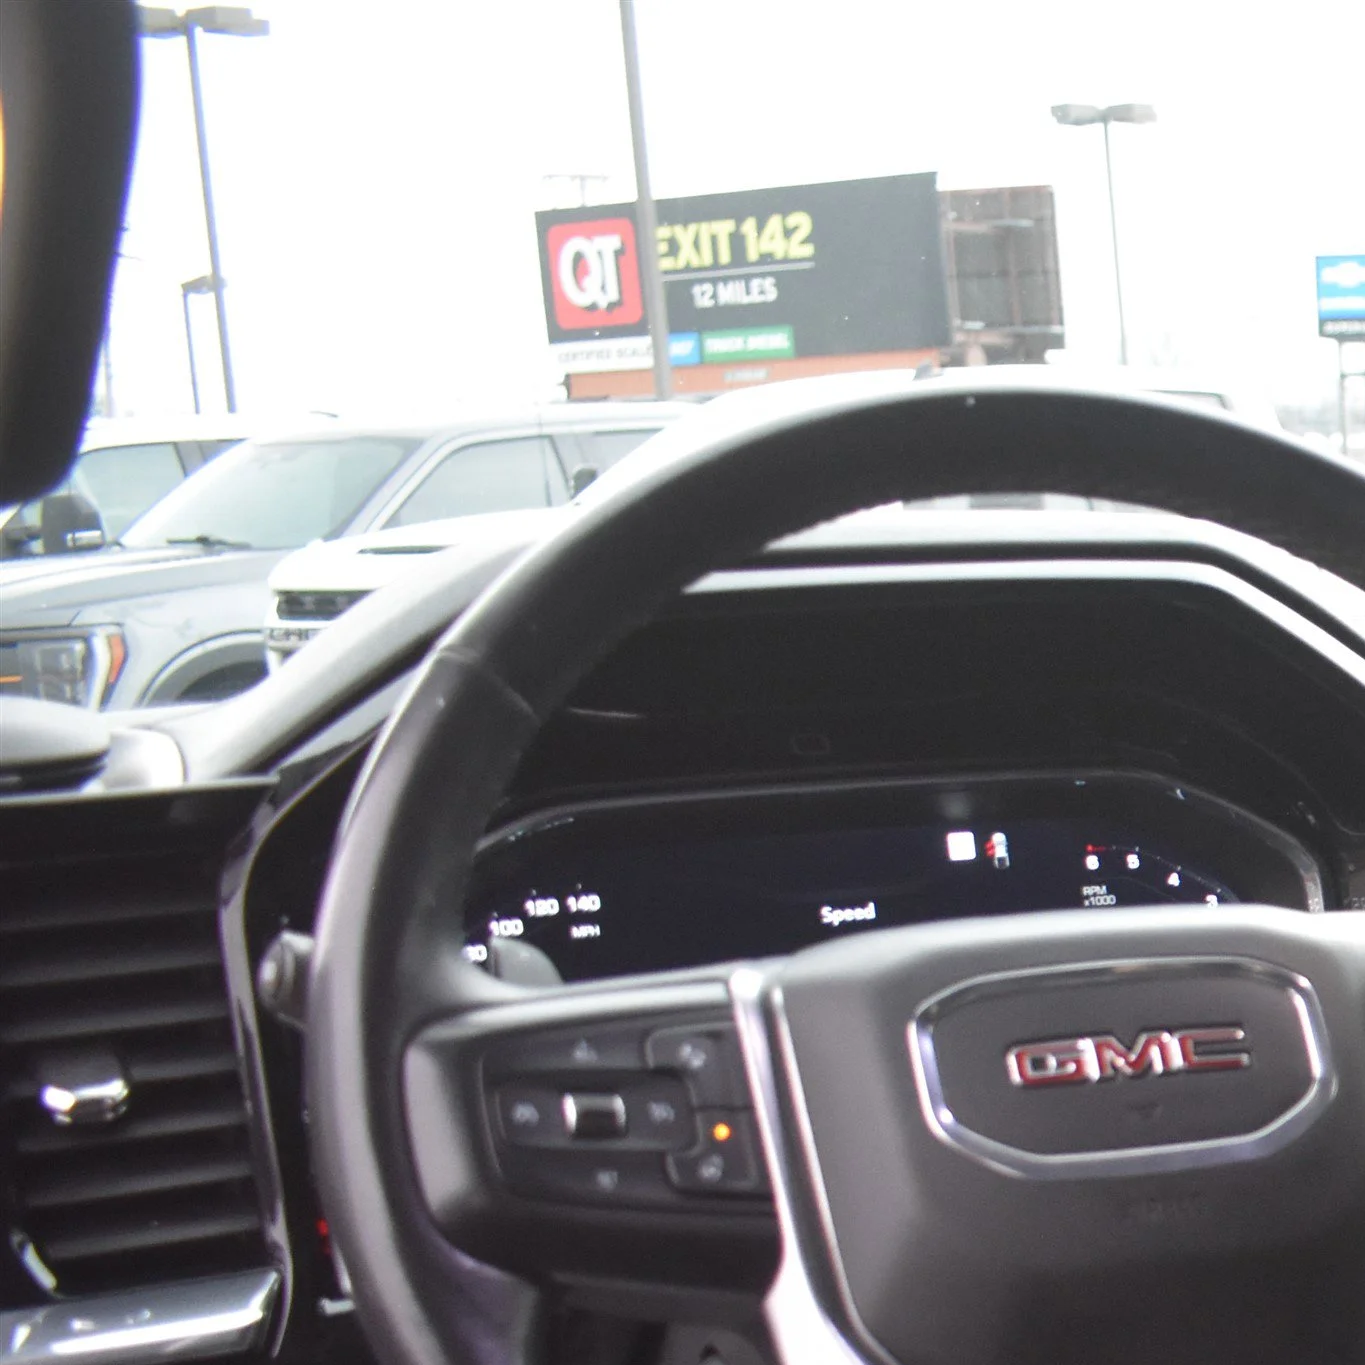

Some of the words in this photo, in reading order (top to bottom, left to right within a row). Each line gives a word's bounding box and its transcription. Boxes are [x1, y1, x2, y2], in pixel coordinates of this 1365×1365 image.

[656, 218, 737, 271] EXIT
[740, 210, 815, 263] 142
[558, 233, 622, 309] QT
[692, 282, 716, 309] 12
[716, 276, 778, 306] MILES
[1082, 885, 1107, 896] RPM
[1168, 872, 1180, 887] 4
[567, 894, 601, 912] 140
[820, 901, 876, 927] Speed
[488, 918, 524, 936] 100
[1006, 1027, 1250, 1086] GMC
